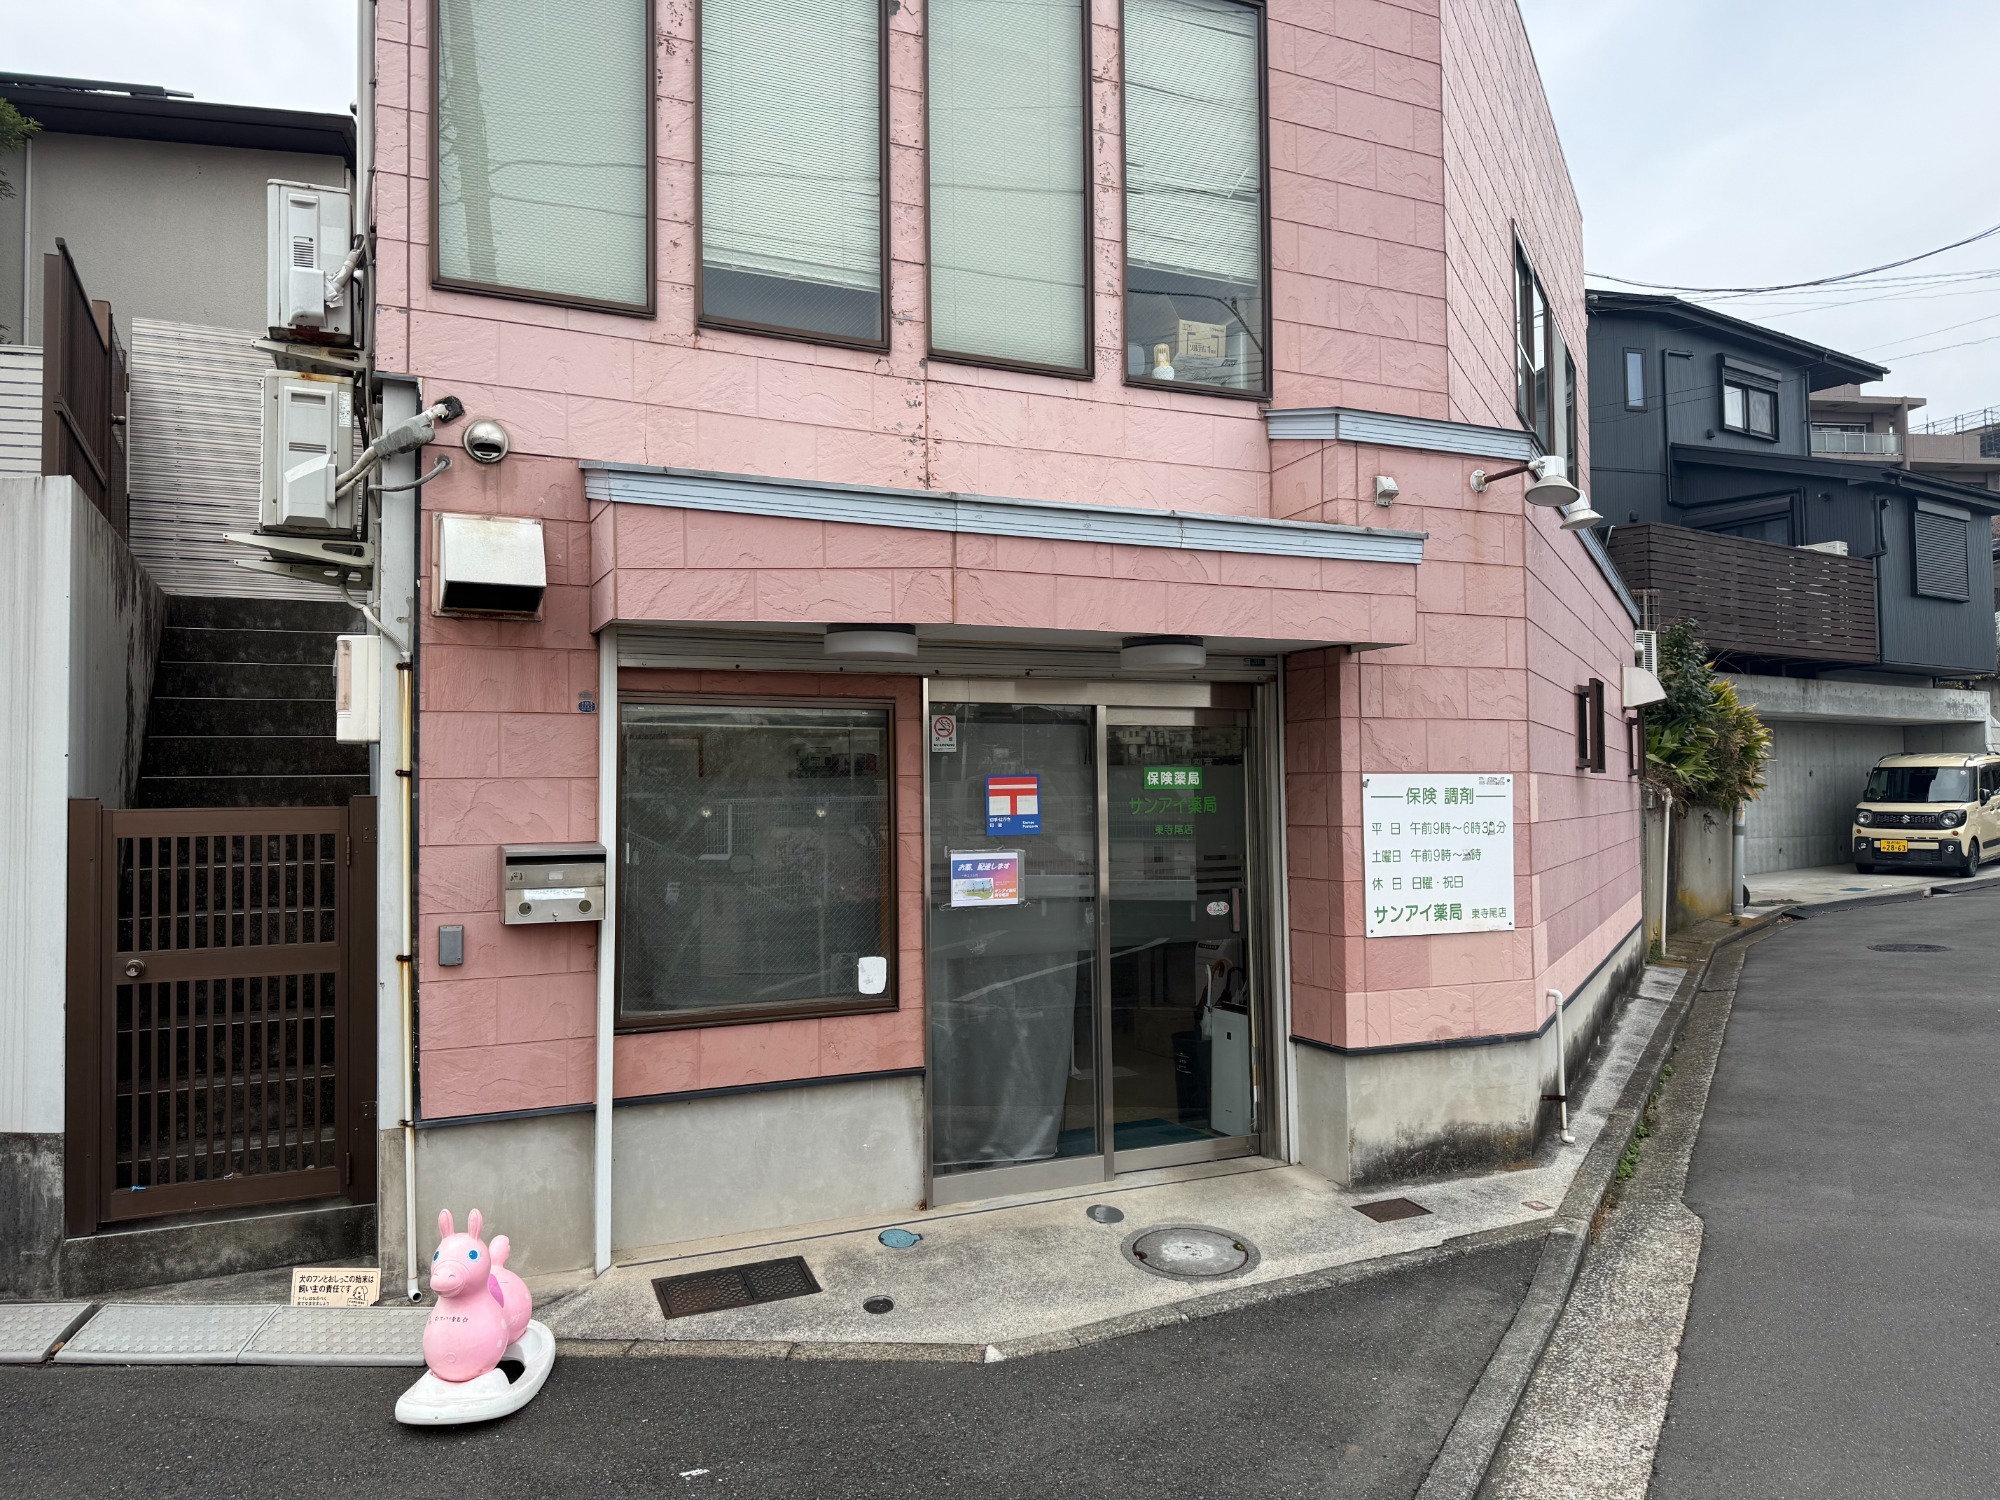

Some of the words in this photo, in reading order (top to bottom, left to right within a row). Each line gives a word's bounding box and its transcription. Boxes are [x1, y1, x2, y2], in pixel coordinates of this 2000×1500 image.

[1147, 771, 1200, 785] 保険薬局
[1406, 787, 1437, 805] 保険
[1444, 787, 1474, 805] 調剤
[1128, 796, 1217, 815] サンアイ薬局
[1154, 824, 1194, 836] 東寺尾店
[1371, 849, 1401, 863] 土曜日
[1410, 848, 1481, 863] 午前9時～時
[1412, 875, 1464, 890] 日曜・祝日
[1374, 903, 1463, 924] サンアイ薬局
[1471, 907, 1507, 919] 東寺尾店
[298, 1274, 374, 1284] 犬のフンとおしっこの始末は
[298, 1284, 352, 1294] 飼い主の責任です
